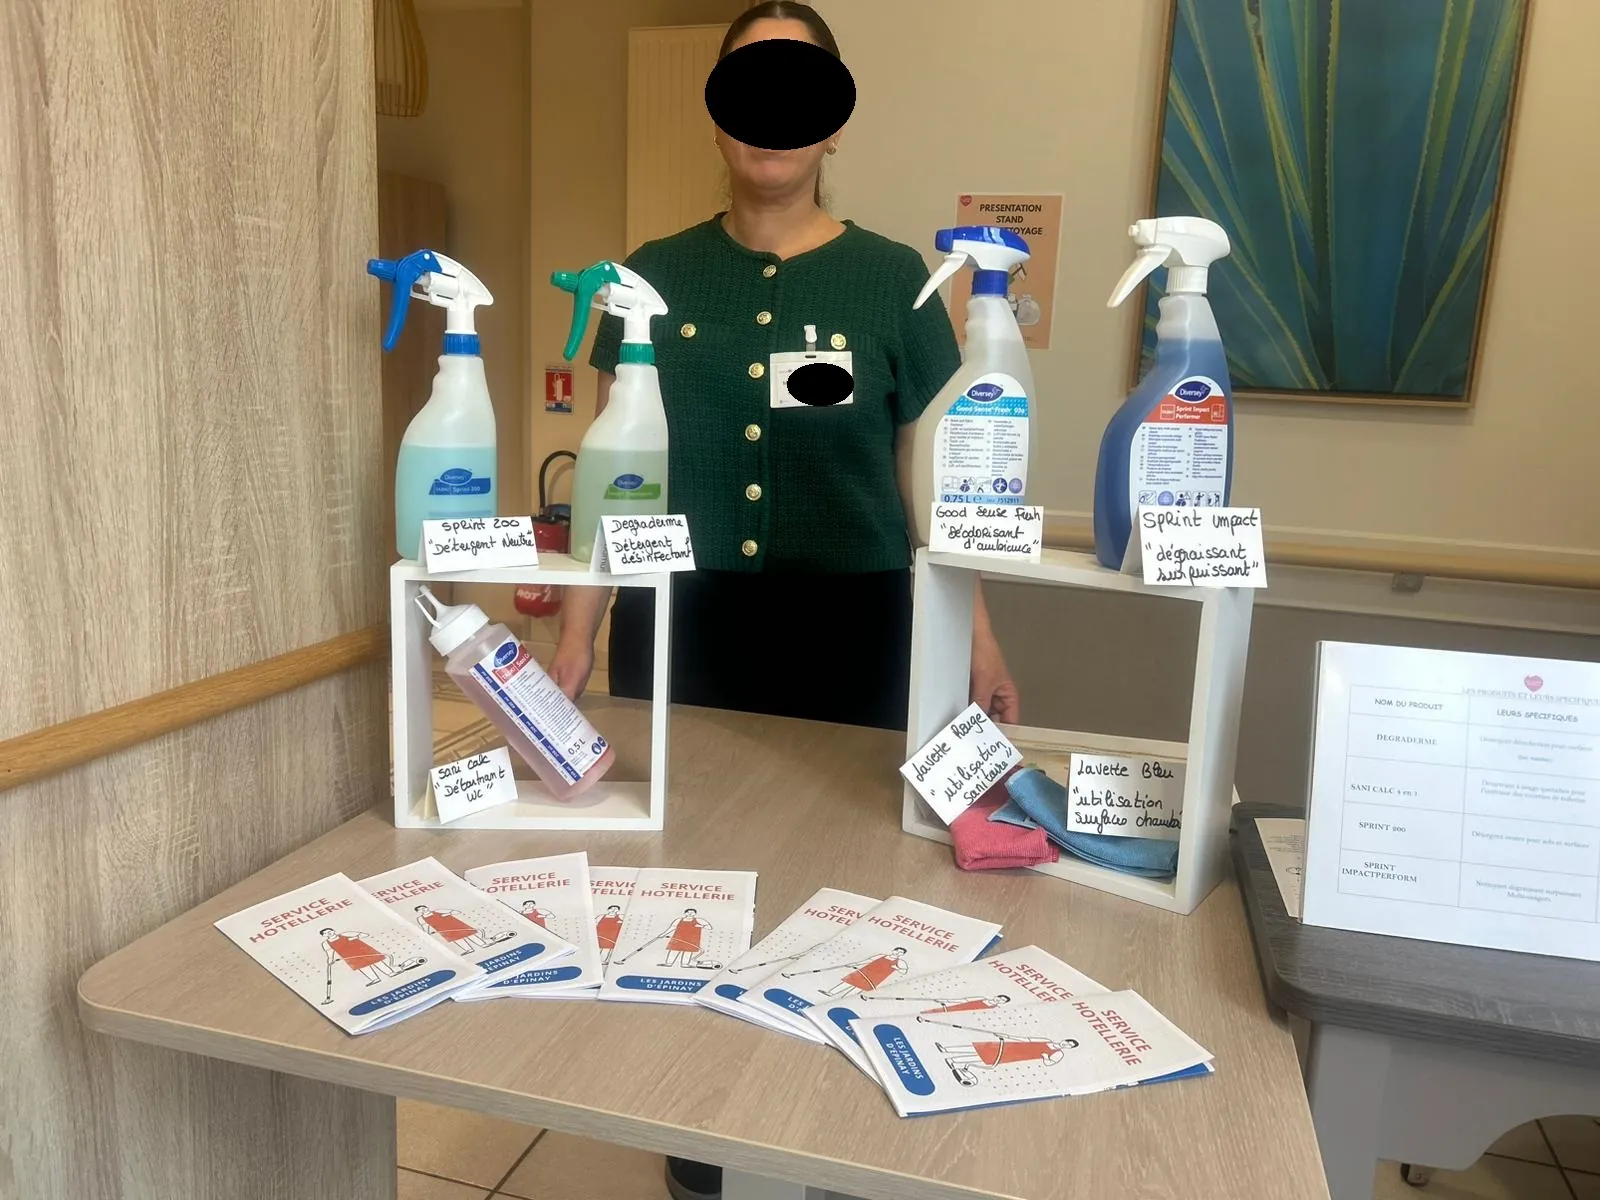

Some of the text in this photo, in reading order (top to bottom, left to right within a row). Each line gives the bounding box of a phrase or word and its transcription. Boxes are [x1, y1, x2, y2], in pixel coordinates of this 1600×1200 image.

[979, 203, 1042, 213] PRESENTATION
[995, 215, 1024, 224] STAND
[971, 389, 994, 399] Diversey
[1179, 388, 1202, 398] Diversey
[1176, 405, 1192, 413] Sprint
[935, 506, 967, 518] Good
[493, 518, 520, 529] 200
[1374, 698, 1443, 710] NOM DU PRODUIT
[1496, 708, 1578, 723] LEURS SPECIFIQUES
[1376, 733, 1438, 746] DEGRADERME
[1350, 783, 1371, 792] SANI
[1372, 786, 1395, 794] CALC
[1359, 821, 1391, 831] SPRINT
[1363, 861, 1396, 872] SPRINT
[492, 872, 556, 884] SERVICE
[1341, 867, 1417, 883] IMPACTPERFORM
[371, 880, 422, 898] ERVICE
[484, 879, 571, 893] OTELLERIE
[589, 880, 636, 888] SERVIC
[660, 882, 723, 892] SERVICE
[381, 881, 444, 904] ELLERIE
[640, 889, 735, 901] HOTELLERIE
[260, 897, 331, 928] SERVICE
[803, 908, 851, 926] HOTEL
[828, 905, 864, 919] SERV
[249, 898, 353, 943] HOTELLERIE
[892, 914, 955, 940] SERVICE
[867, 916, 960, 952] HOTELLERIE
[485, 950, 522, 966] JARDINS
[660, 979, 702, 987] JARDINS
[988, 960, 1057, 1002] HOTELLER
[1015, 963, 1074, 1000] SERVICE
[370, 977, 431, 1005] LES JARDINS
[787, 996, 805, 1006] LES
[1072, 1001, 1142, 1066] HOTELLERIE
[1101, 1009, 1152, 1052] SERVICE
[893, 1037, 924, 1079] LES JARDINS
